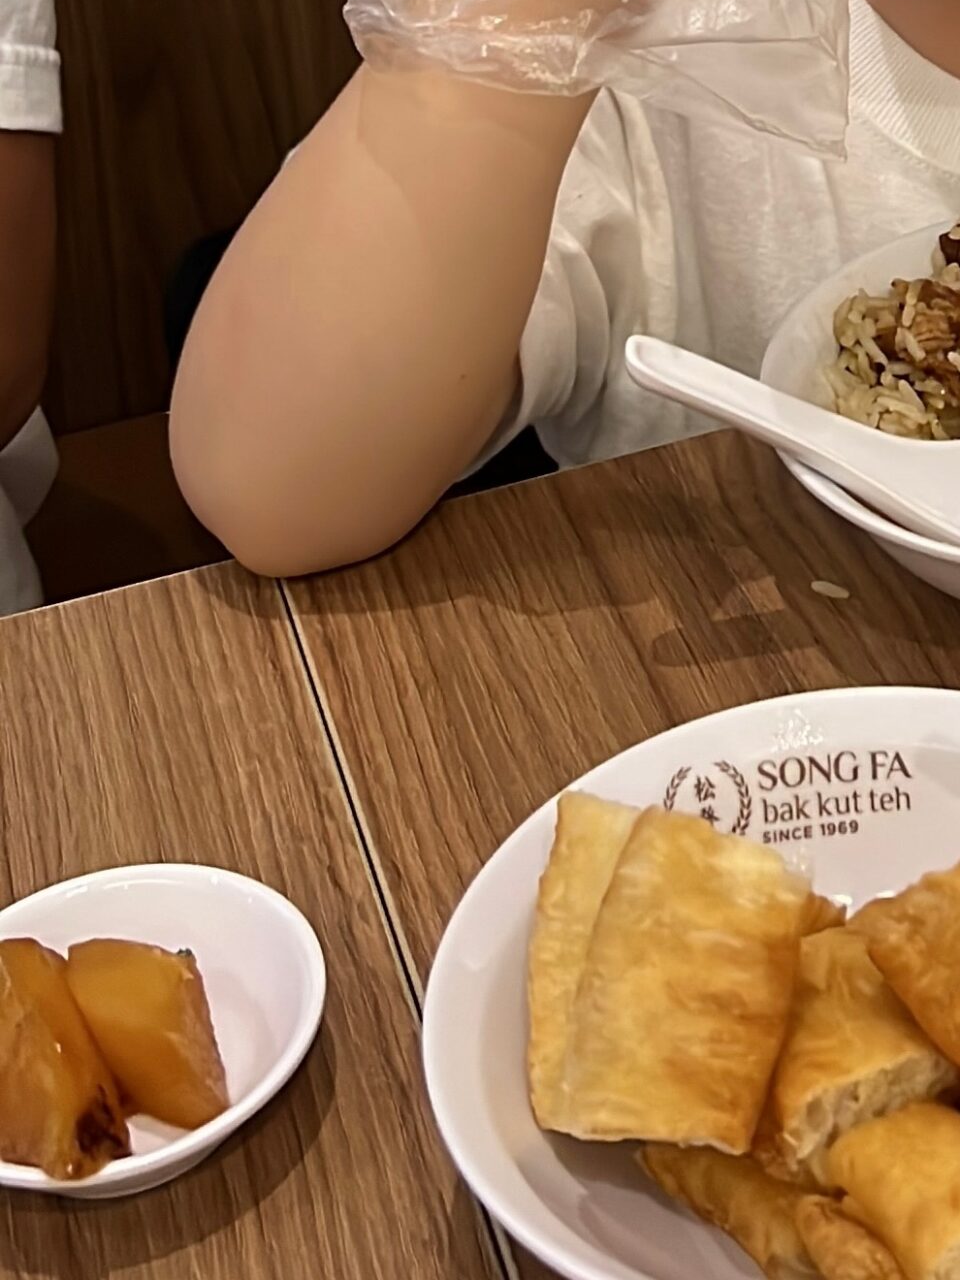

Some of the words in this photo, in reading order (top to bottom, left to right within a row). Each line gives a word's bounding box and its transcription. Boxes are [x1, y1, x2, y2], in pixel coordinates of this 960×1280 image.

[757, 750, 860, 792] SONG
[869, 750, 912, 781] FA
[762, 795, 811, 824] bak
[816, 790, 863, 818] kut
[869, 786, 912, 812] teh
[762, 824, 813, 844] SINCE
[820, 820, 860, 837] 1969
